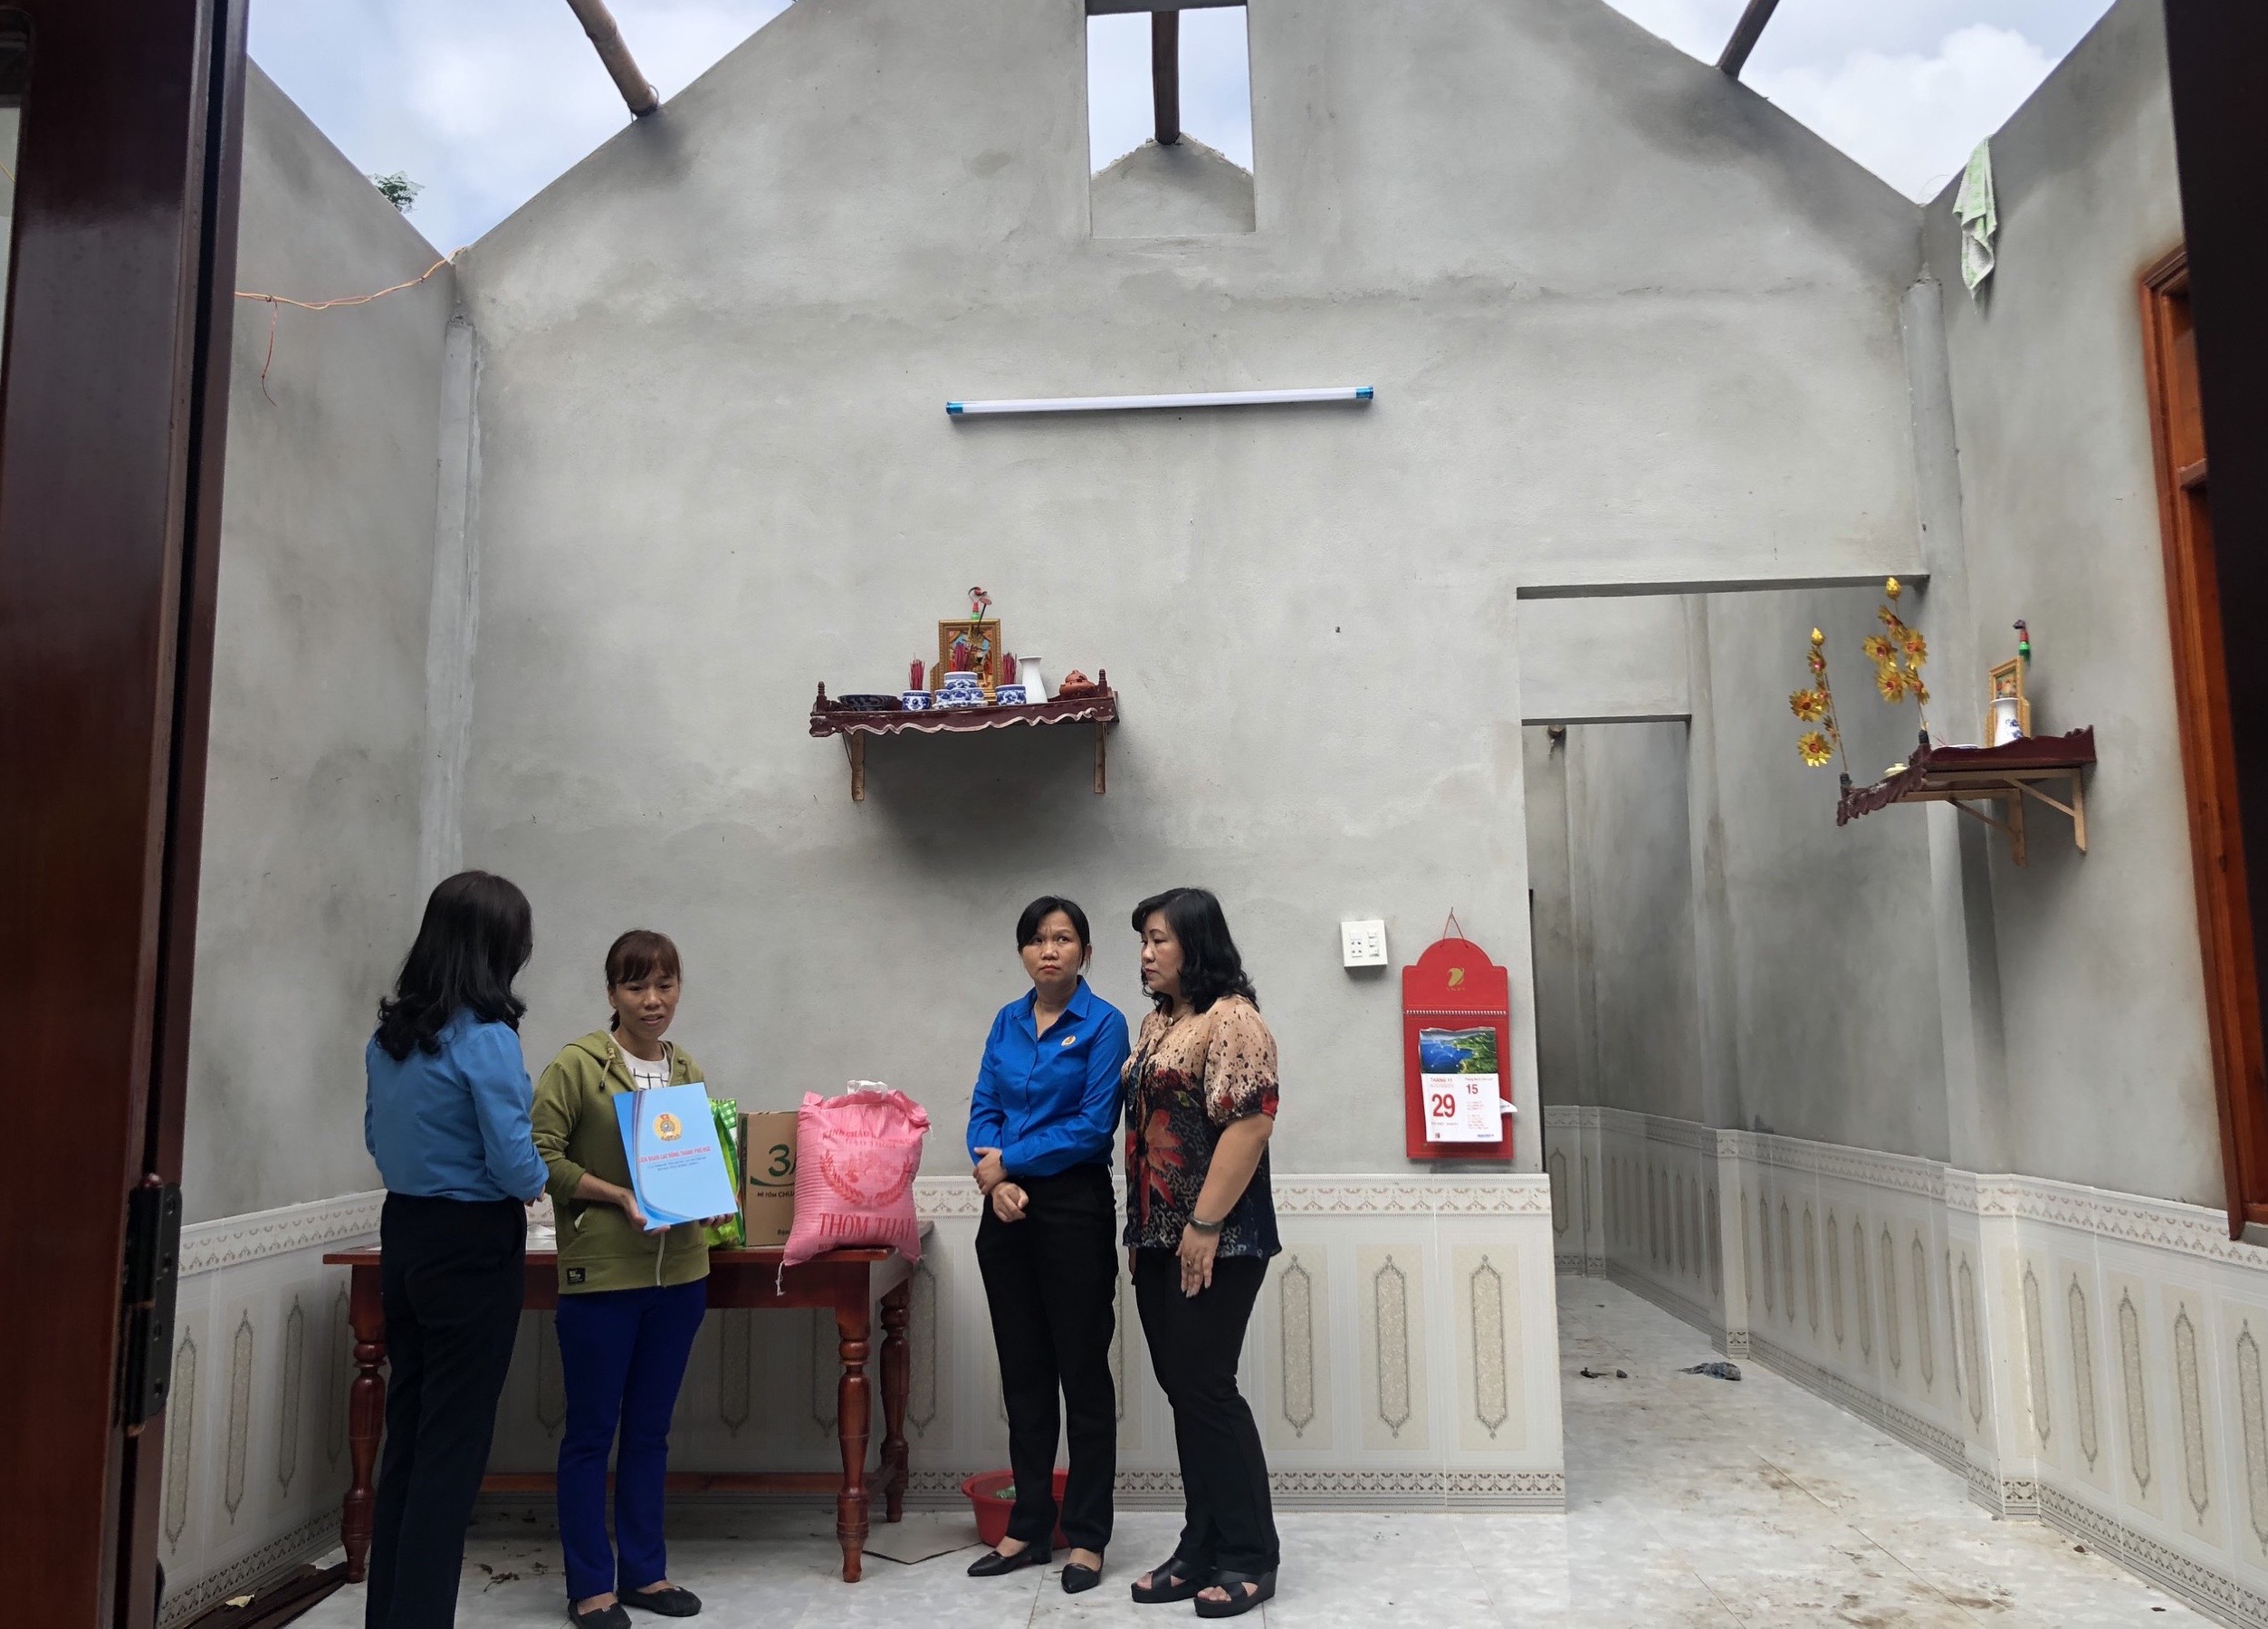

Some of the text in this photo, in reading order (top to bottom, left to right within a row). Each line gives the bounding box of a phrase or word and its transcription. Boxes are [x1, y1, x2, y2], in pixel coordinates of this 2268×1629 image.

[1466, 1083, 1479, 1095] 15
[1431, 1093, 1456, 1118] 29
[768, 1144, 797, 1177] 3
[818, 1212, 869, 1239] THƠM
